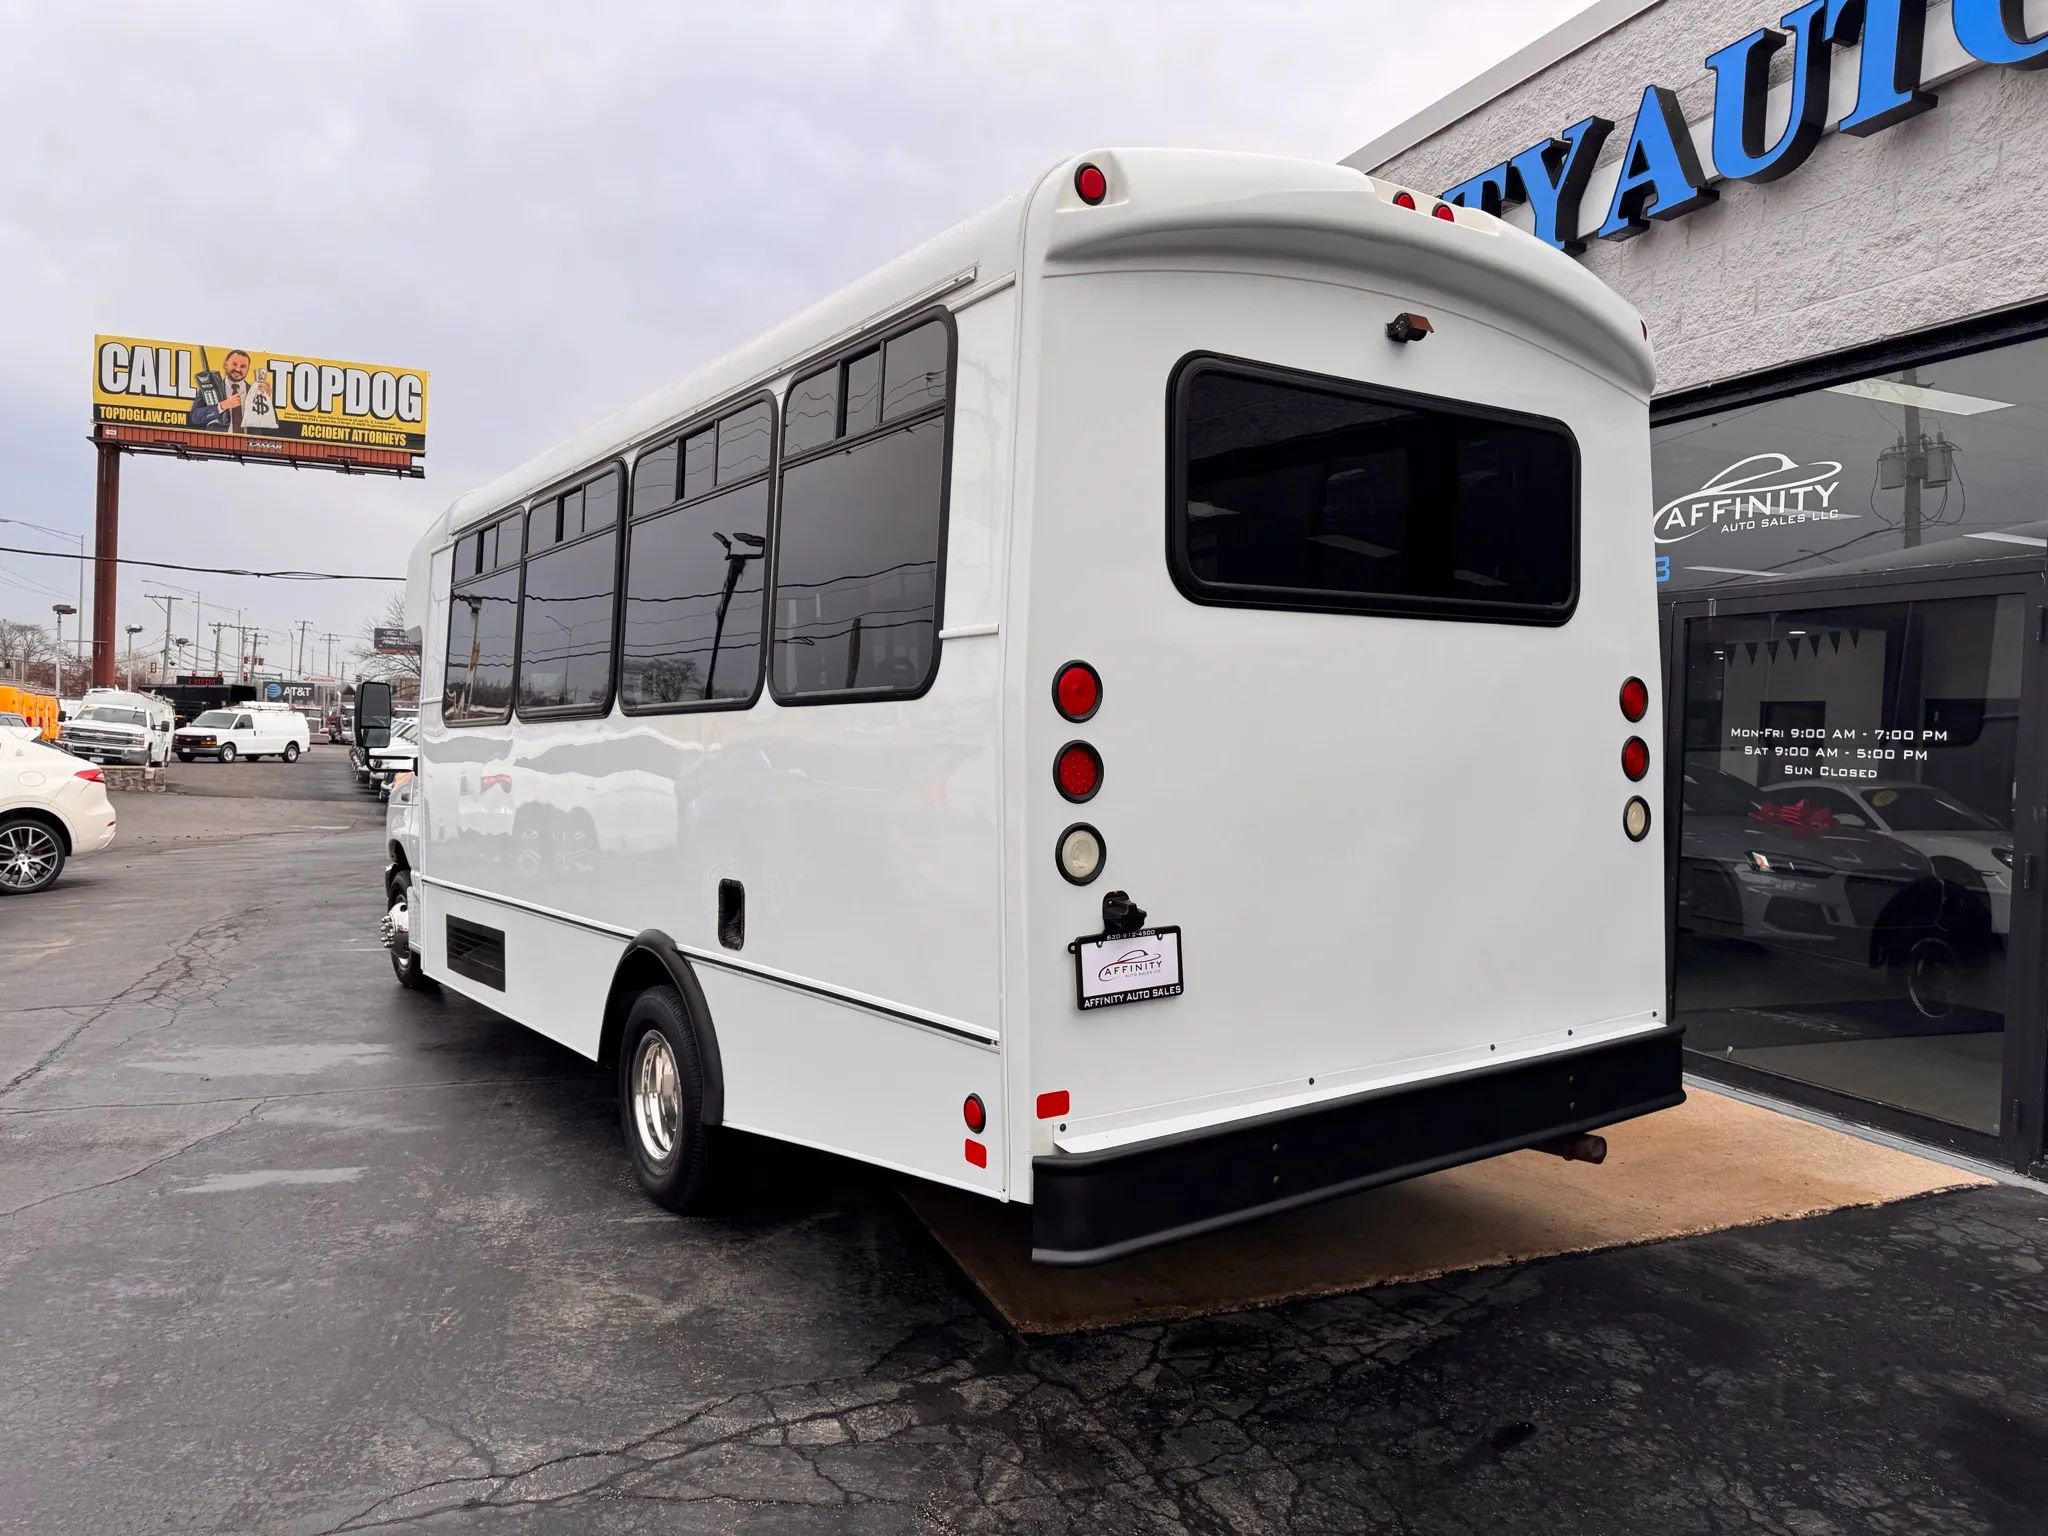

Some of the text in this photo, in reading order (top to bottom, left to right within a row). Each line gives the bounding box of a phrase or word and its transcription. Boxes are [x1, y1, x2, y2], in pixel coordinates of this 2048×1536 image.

[99, 341, 197, 400] CALL
[267, 359, 423, 423] TOPDOG
[99, 405, 187, 425] TOPDOGLAW.COM
[301, 424, 407, 446] ACCIDENT ATTORNEYS
[1664, 481, 1840, 531] AFFINITY
[1720, 509, 1839, 534] AUTO SALES LLC
[283, 686, 312, 697] AT&T
[1790, 728, 1826, 739] 9:00
[1832, 729, 1856, 739] AM
[1874, 730, 1914, 740] 7:00
[1922, 730, 1948, 741] PM
[1774, 746, 1809, 757] 9:00
[1815, 747, 1838, 757] AM
[1856, 749, 1895, 760] 5:00
[1903, 750, 1928, 760] PM
[1104, 960, 1162, 976] AFFINITY
[1084, 985, 1182, 1008] AFFINITY AUTO SALES
